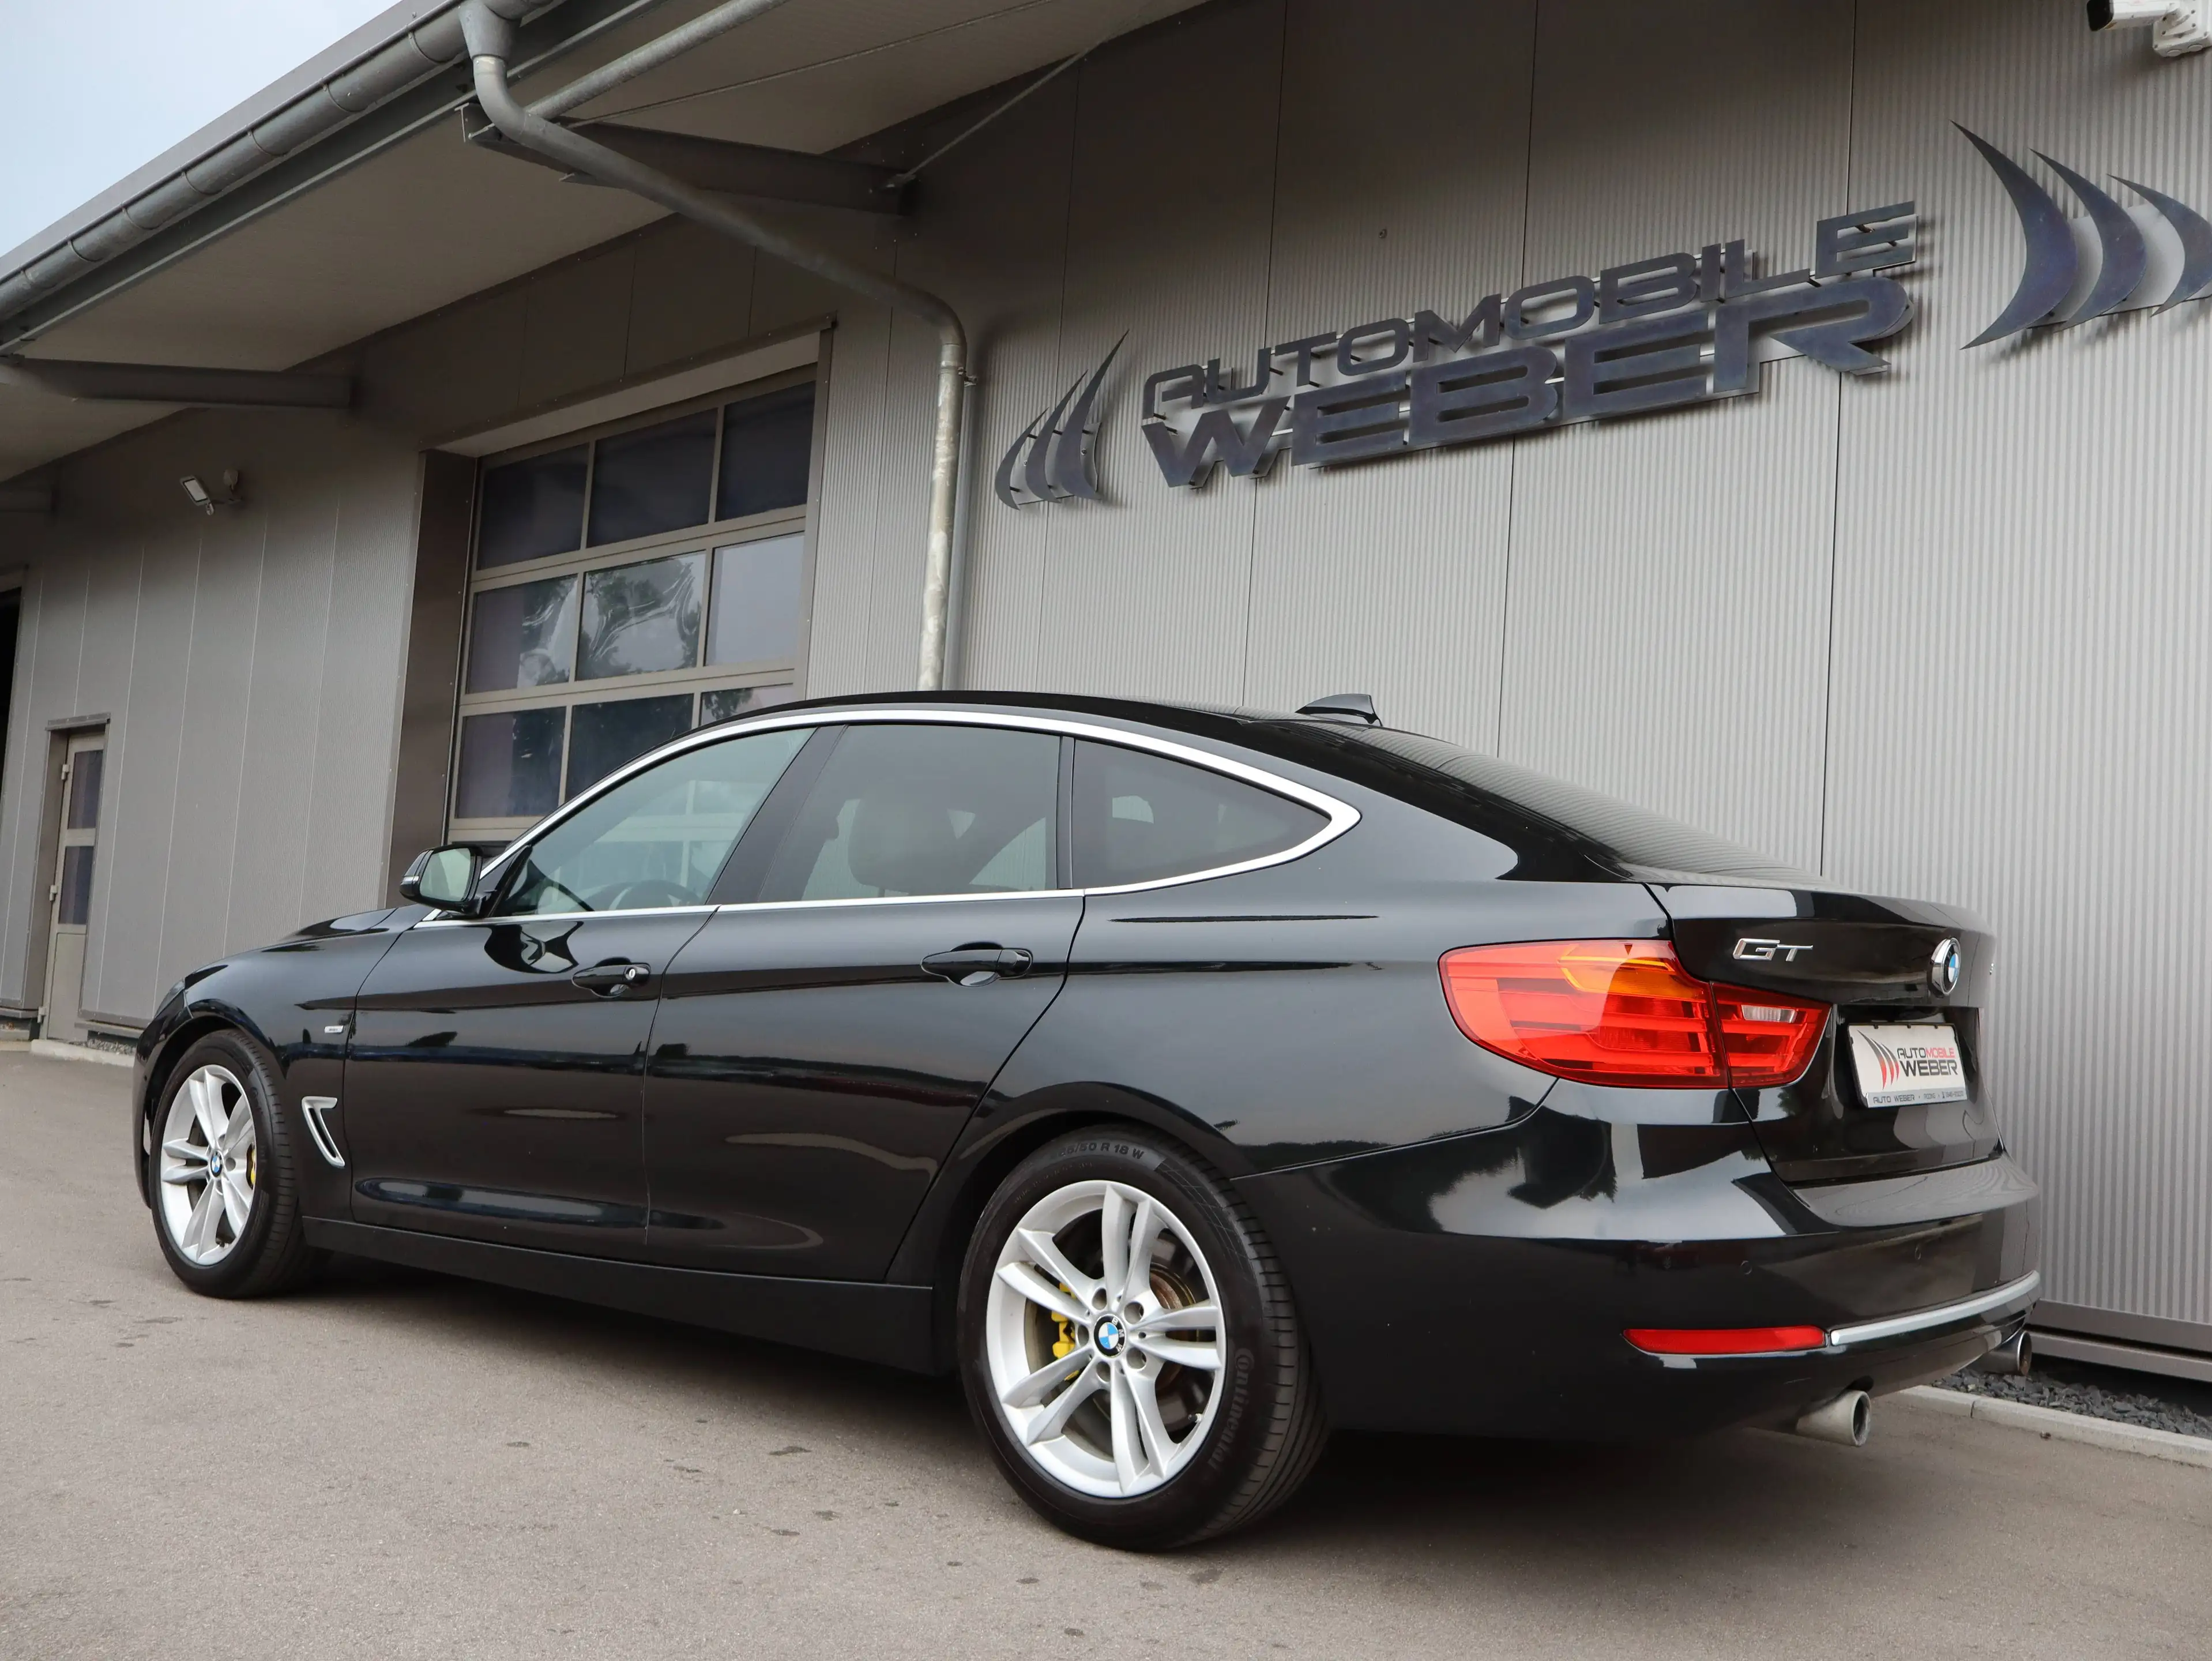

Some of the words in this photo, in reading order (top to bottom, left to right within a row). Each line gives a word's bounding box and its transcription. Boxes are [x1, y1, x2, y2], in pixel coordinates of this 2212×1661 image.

[1143, 201, 1916, 420] AUTOMOBILE
[1141, 277, 1910, 488] WEBER
[1733, 938, 1814, 961] GT
[1897, 1047, 1955, 1059] AUTOMOBILE
[1899, 1059, 1958, 1077] WEBER
[1873, 1096, 1891, 1104] AUTO
[1894, 1093, 1916, 1103] WEBER
[1100, 1142, 1111, 1152] R
[1113, 1143, 1129, 1155] 18
[1131, 1148, 1145, 1160] W
